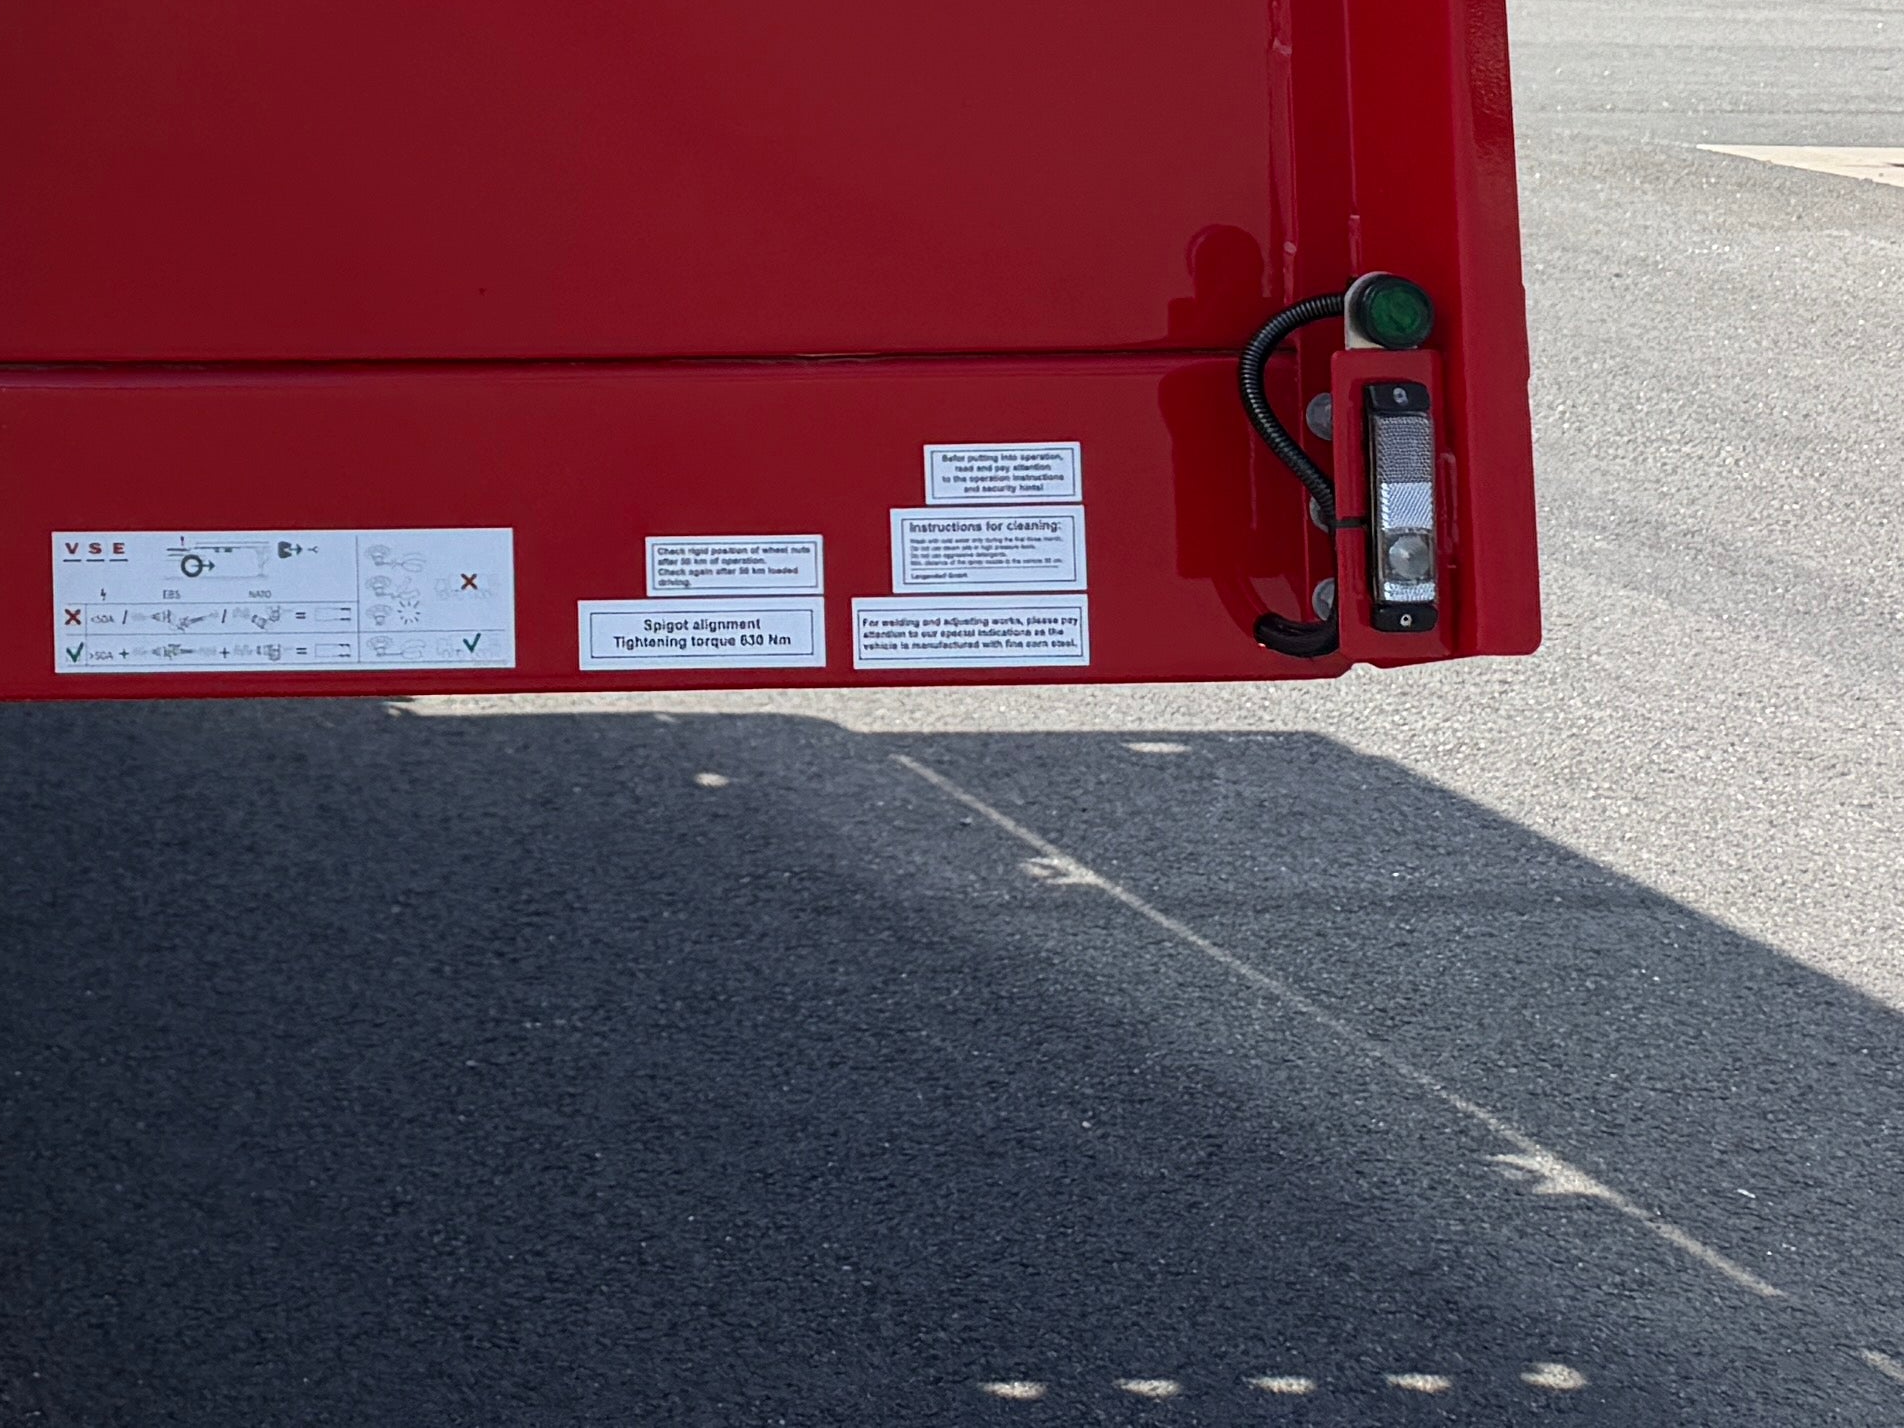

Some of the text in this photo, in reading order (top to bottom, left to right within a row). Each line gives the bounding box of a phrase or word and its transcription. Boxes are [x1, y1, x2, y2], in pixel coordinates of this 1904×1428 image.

[968, 454, 998, 463] putting
[977, 464, 992, 472] and
[995, 465, 1010, 473] pay
[1013, 463, 1051, 471] attention
[942, 475, 950, 483] to
[969, 474, 1010, 483] operation
[964, 485, 980, 493] and
[982, 485, 1016, 493] security
[909, 520, 1061, 533] Instructions for cleaning:
[658, 546, 810, 556] Check rigid position of wheel nuts
[658, 558, 678, 566] after
[710, 557, 719, 565] of
[658, 568, 686, 576] Check
[689, 568, 713, 577] again
[716, 567, 736, 575] after
[644, 618, 761, 633] Spigot alignment
[863, 618, 878, 626] For
[882, 618, 919, 627] welding
[922, 618, 940, 626] and
[944, 617, 989, 627] adjusting
[1027, 617, 1058, 625] please
[1061, 618, 1078, 626] pay
[863, 630, 906, 638] attention
[941, 629, 975, 638] special
[1048, 628, 1064, 636] the
[614, 635, 687, 651] Tightening
[691, 636, 736, 649] torque
[768, 634, 791, 645] Nm
[863, 642, 897, 650] vehicle
[912, 641, 979, 649] manufactured
[982, 640, 1003, 648] with
[1005, 639, 1023, 648] fine
